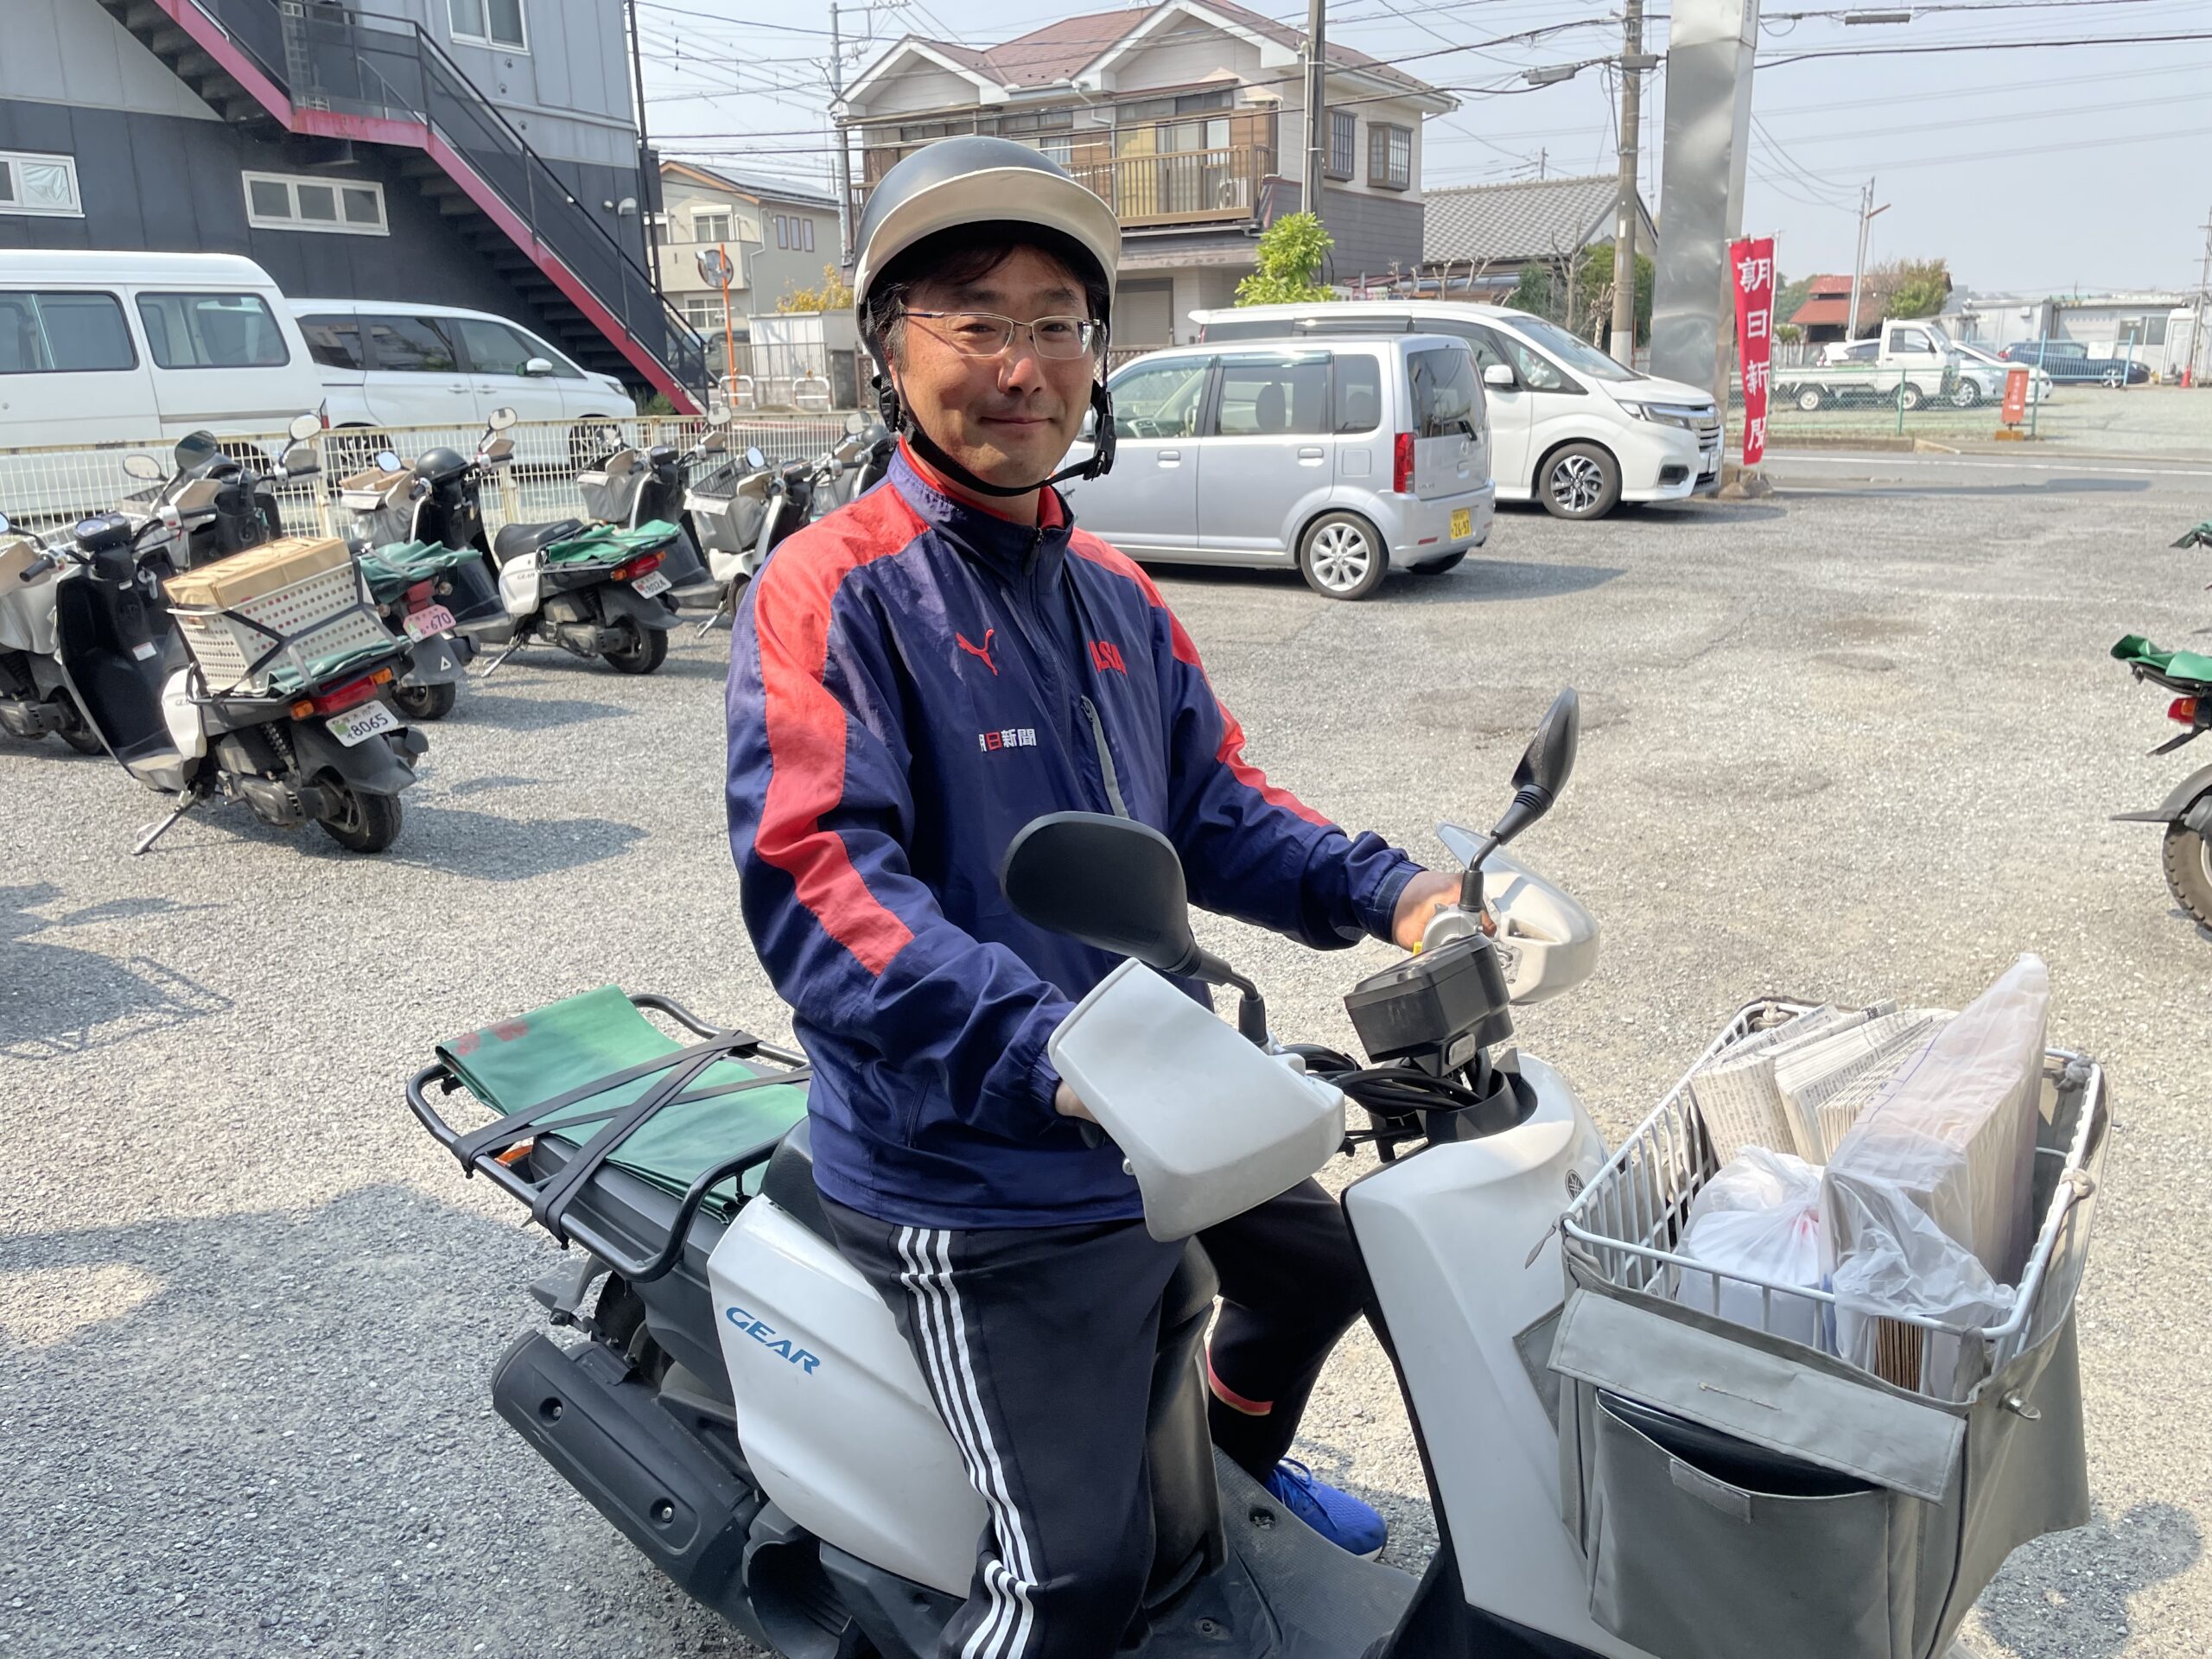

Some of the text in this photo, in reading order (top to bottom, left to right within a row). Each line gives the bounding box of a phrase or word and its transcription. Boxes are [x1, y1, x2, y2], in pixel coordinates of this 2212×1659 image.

[1088, 640, 1128, 676] ASA
[351, 713, 389, 737] 8065
[726, 1306, 821, 1375] GEAR
